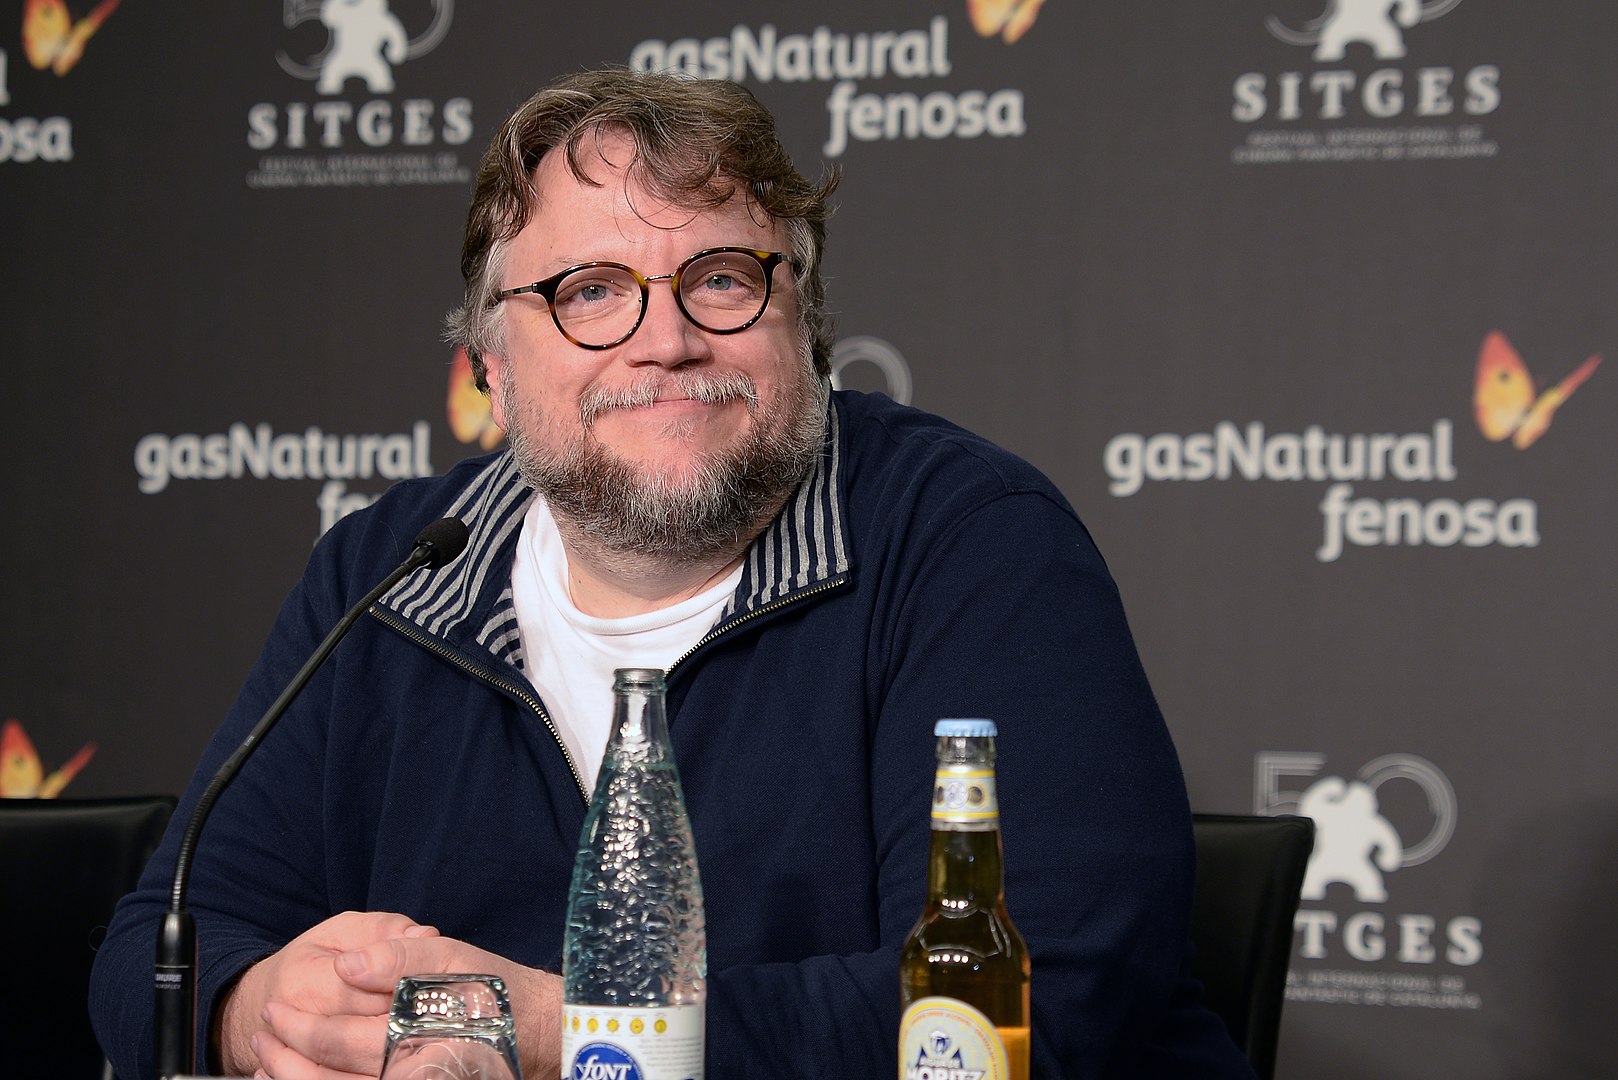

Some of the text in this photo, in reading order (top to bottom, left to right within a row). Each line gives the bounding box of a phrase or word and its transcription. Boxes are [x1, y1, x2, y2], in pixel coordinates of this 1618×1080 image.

[248, 98, 474, 149] SITGES
[822, 82, 1026, 158] fenosa
[1232, 65, 1501, 122] SITGES
[134, 420, 435, 494] gasNatural
[1104, 418, 1457, 497] gasNatural
[1316, 482, 1541, 563] fenosa
[1294, 909, 1483, 966] TGES
